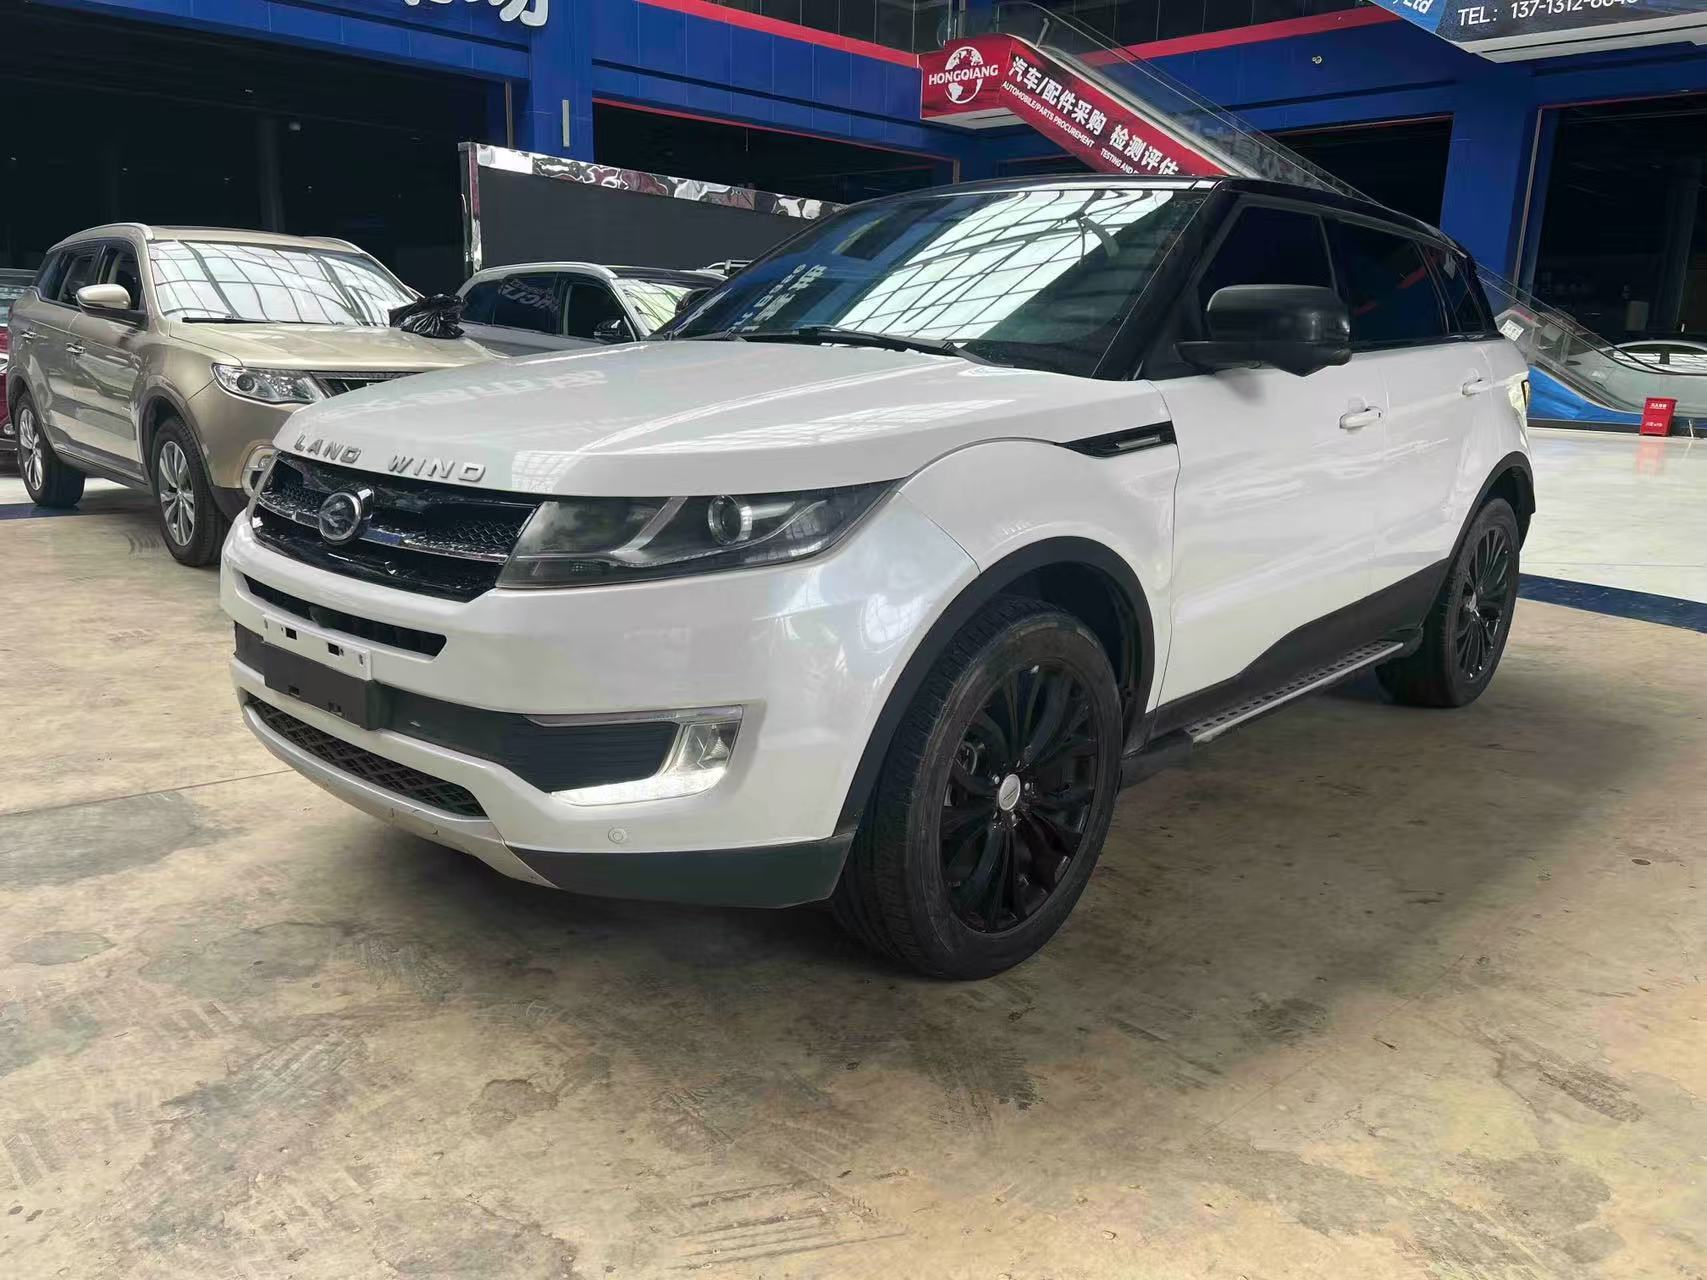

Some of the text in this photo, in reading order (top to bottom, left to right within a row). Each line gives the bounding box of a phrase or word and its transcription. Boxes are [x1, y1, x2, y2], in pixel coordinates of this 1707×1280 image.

[1510, 0, 1638, 19] 137-1312-
[928, 64, 999, 85] HONGQIANG
[1002, 81, 1134, 174] AUTOMOBILE/PARTS PROCUREMENT TESTING AND
[1008, 56, 1179, 174] 汽车/配件采购 检测评估
[294, 434, 486, 483] LAND WIND
